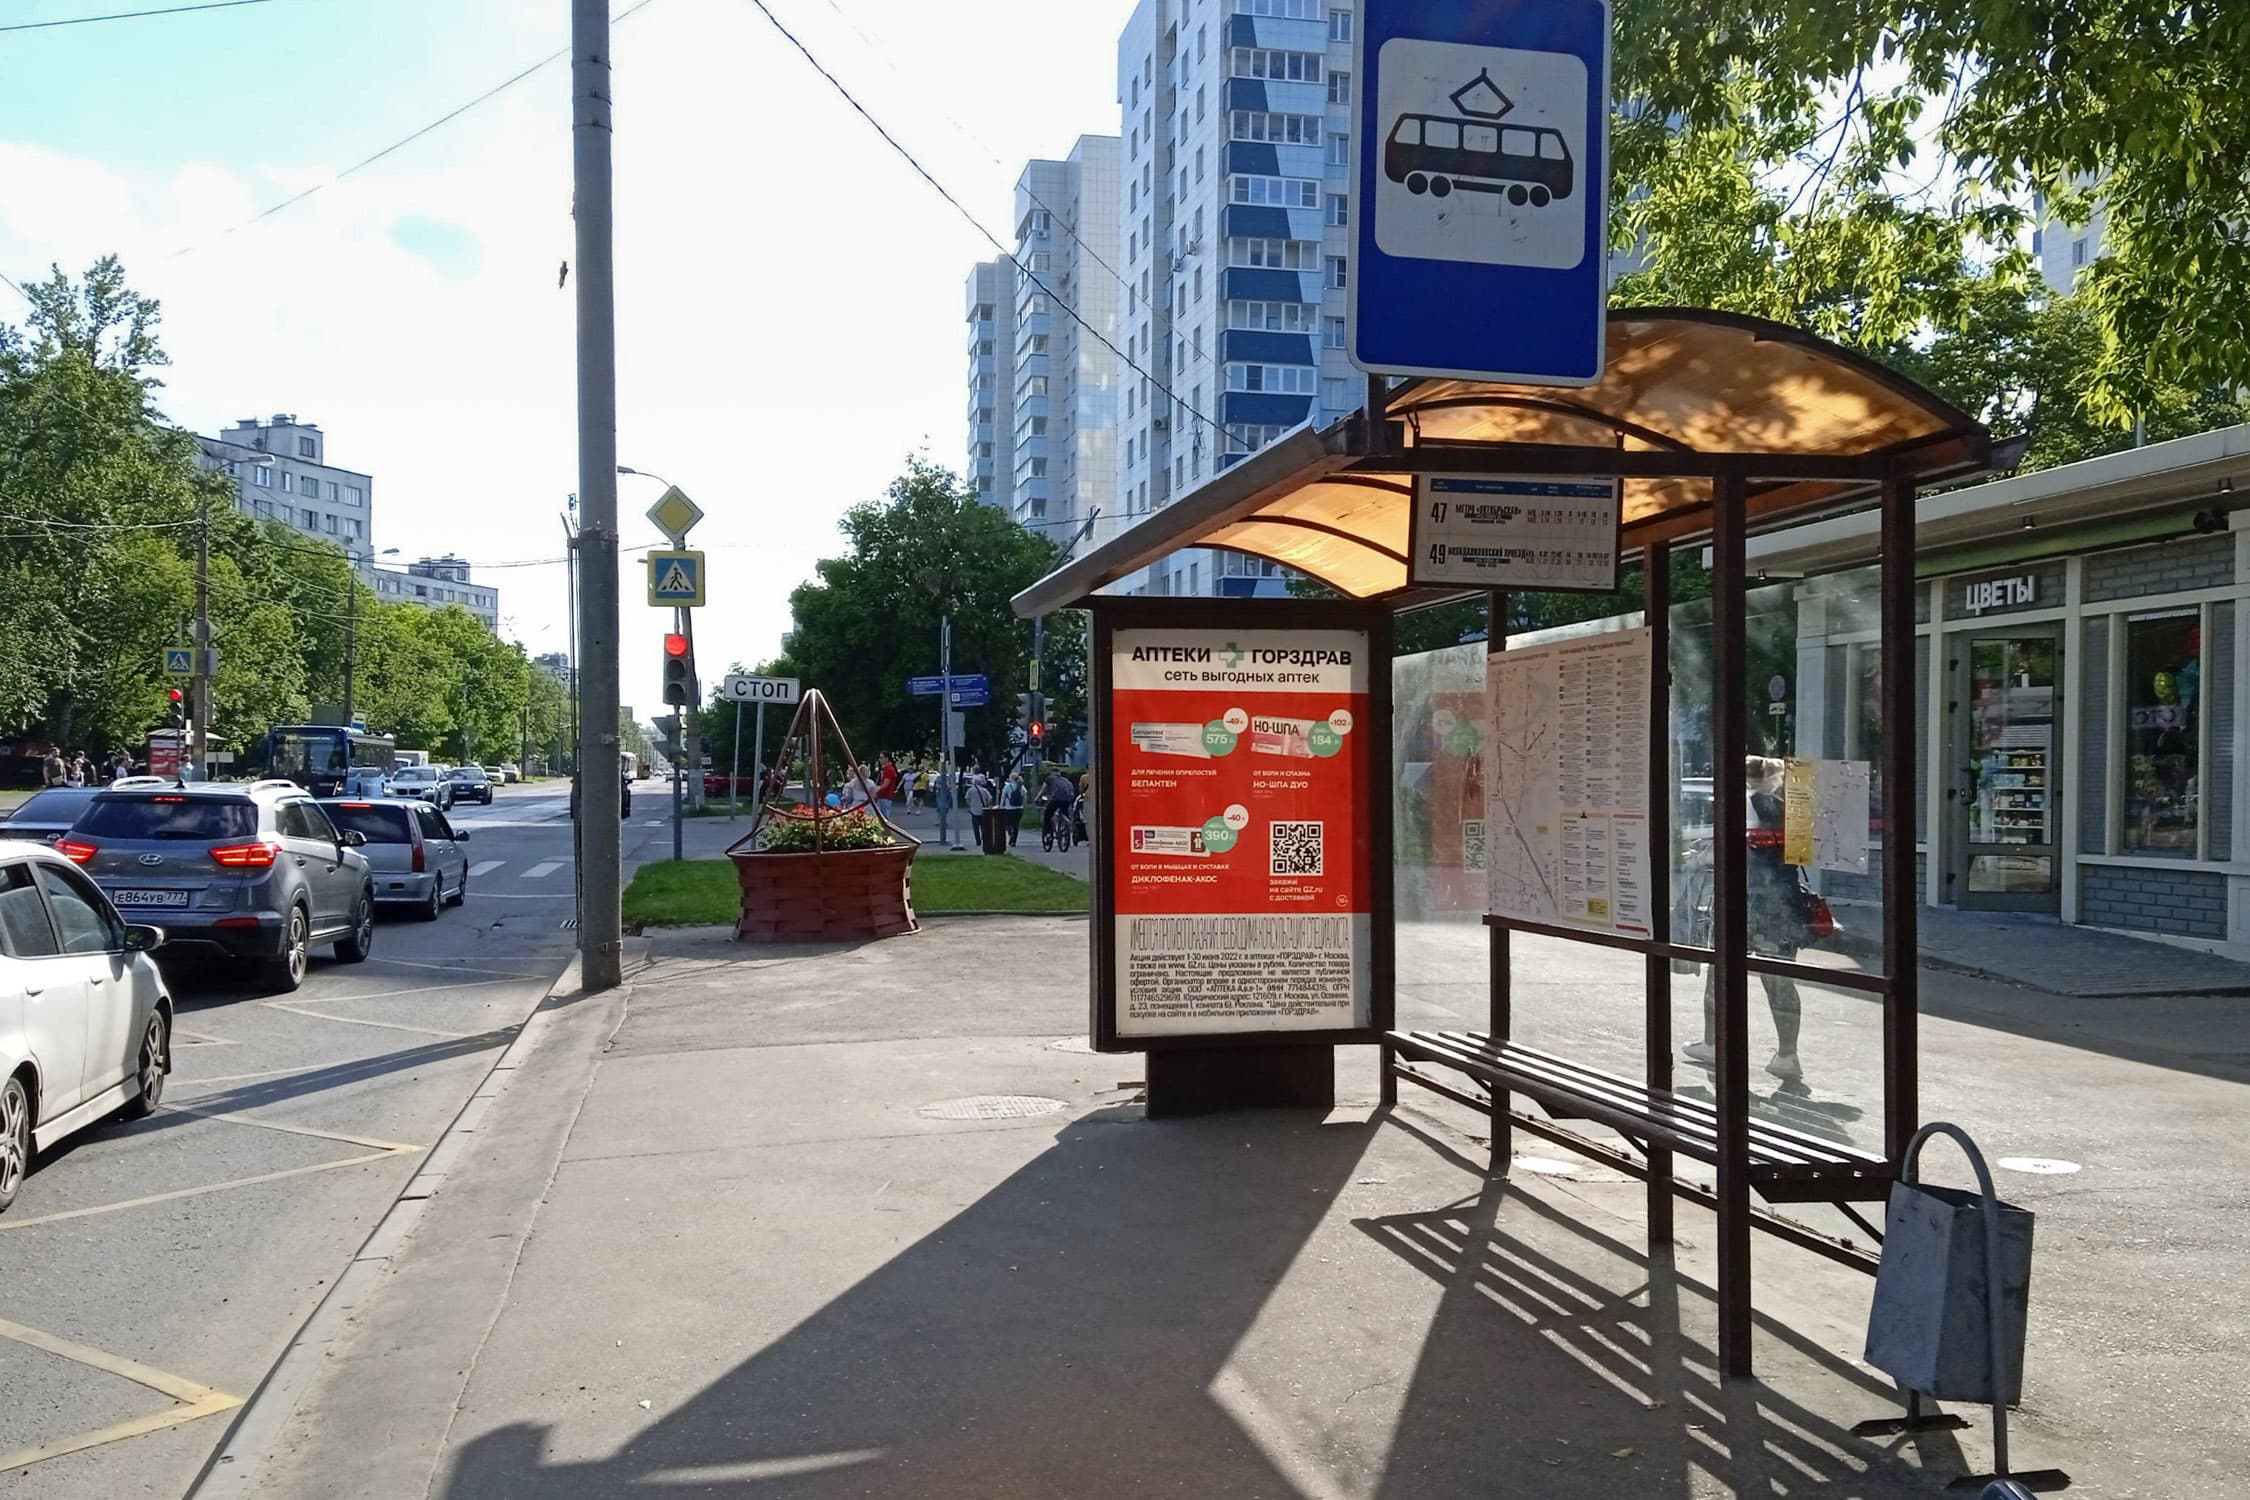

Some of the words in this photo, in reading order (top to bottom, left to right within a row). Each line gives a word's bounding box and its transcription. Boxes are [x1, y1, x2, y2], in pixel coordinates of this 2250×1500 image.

[1431, 502, 1448, 523] 47
[1429, 543, 1447, 564] 49
[1965, 576, 2035, 615] ЦВЕТЫ
[1132, 646, 1211, 663] АПТЕКИ
[1252, 649, 1352, 667] ГОРЗДРАВ
[1164, 670, 1198, 682] сеть
[1201, 670, 1275, 683] выгодных
[1278, 672, 1320, 683] аптек
[735, 680, 788, 699] СТОП
[1254, 720, 1300, 737] НО-ШПА
[1206, 733, 1228, 744] 575
[1311, 735, 1332, 745] 184
[1131, 780, 1177, 788] БЕПАНТЕН
[1253, 781, 1289, 789] НО-ШПА
[1289, 781, 1309, 790] ДУО
[1205, 830, 1229, 841] 390
[1131, 876, 1217, 884] ДИКЛОФЕНАК-АКОС
[117, 891, 164, 904] Е864УВ
[166, 891, 184, 900] 777
[1220, 952, 1238, 960] 2022
